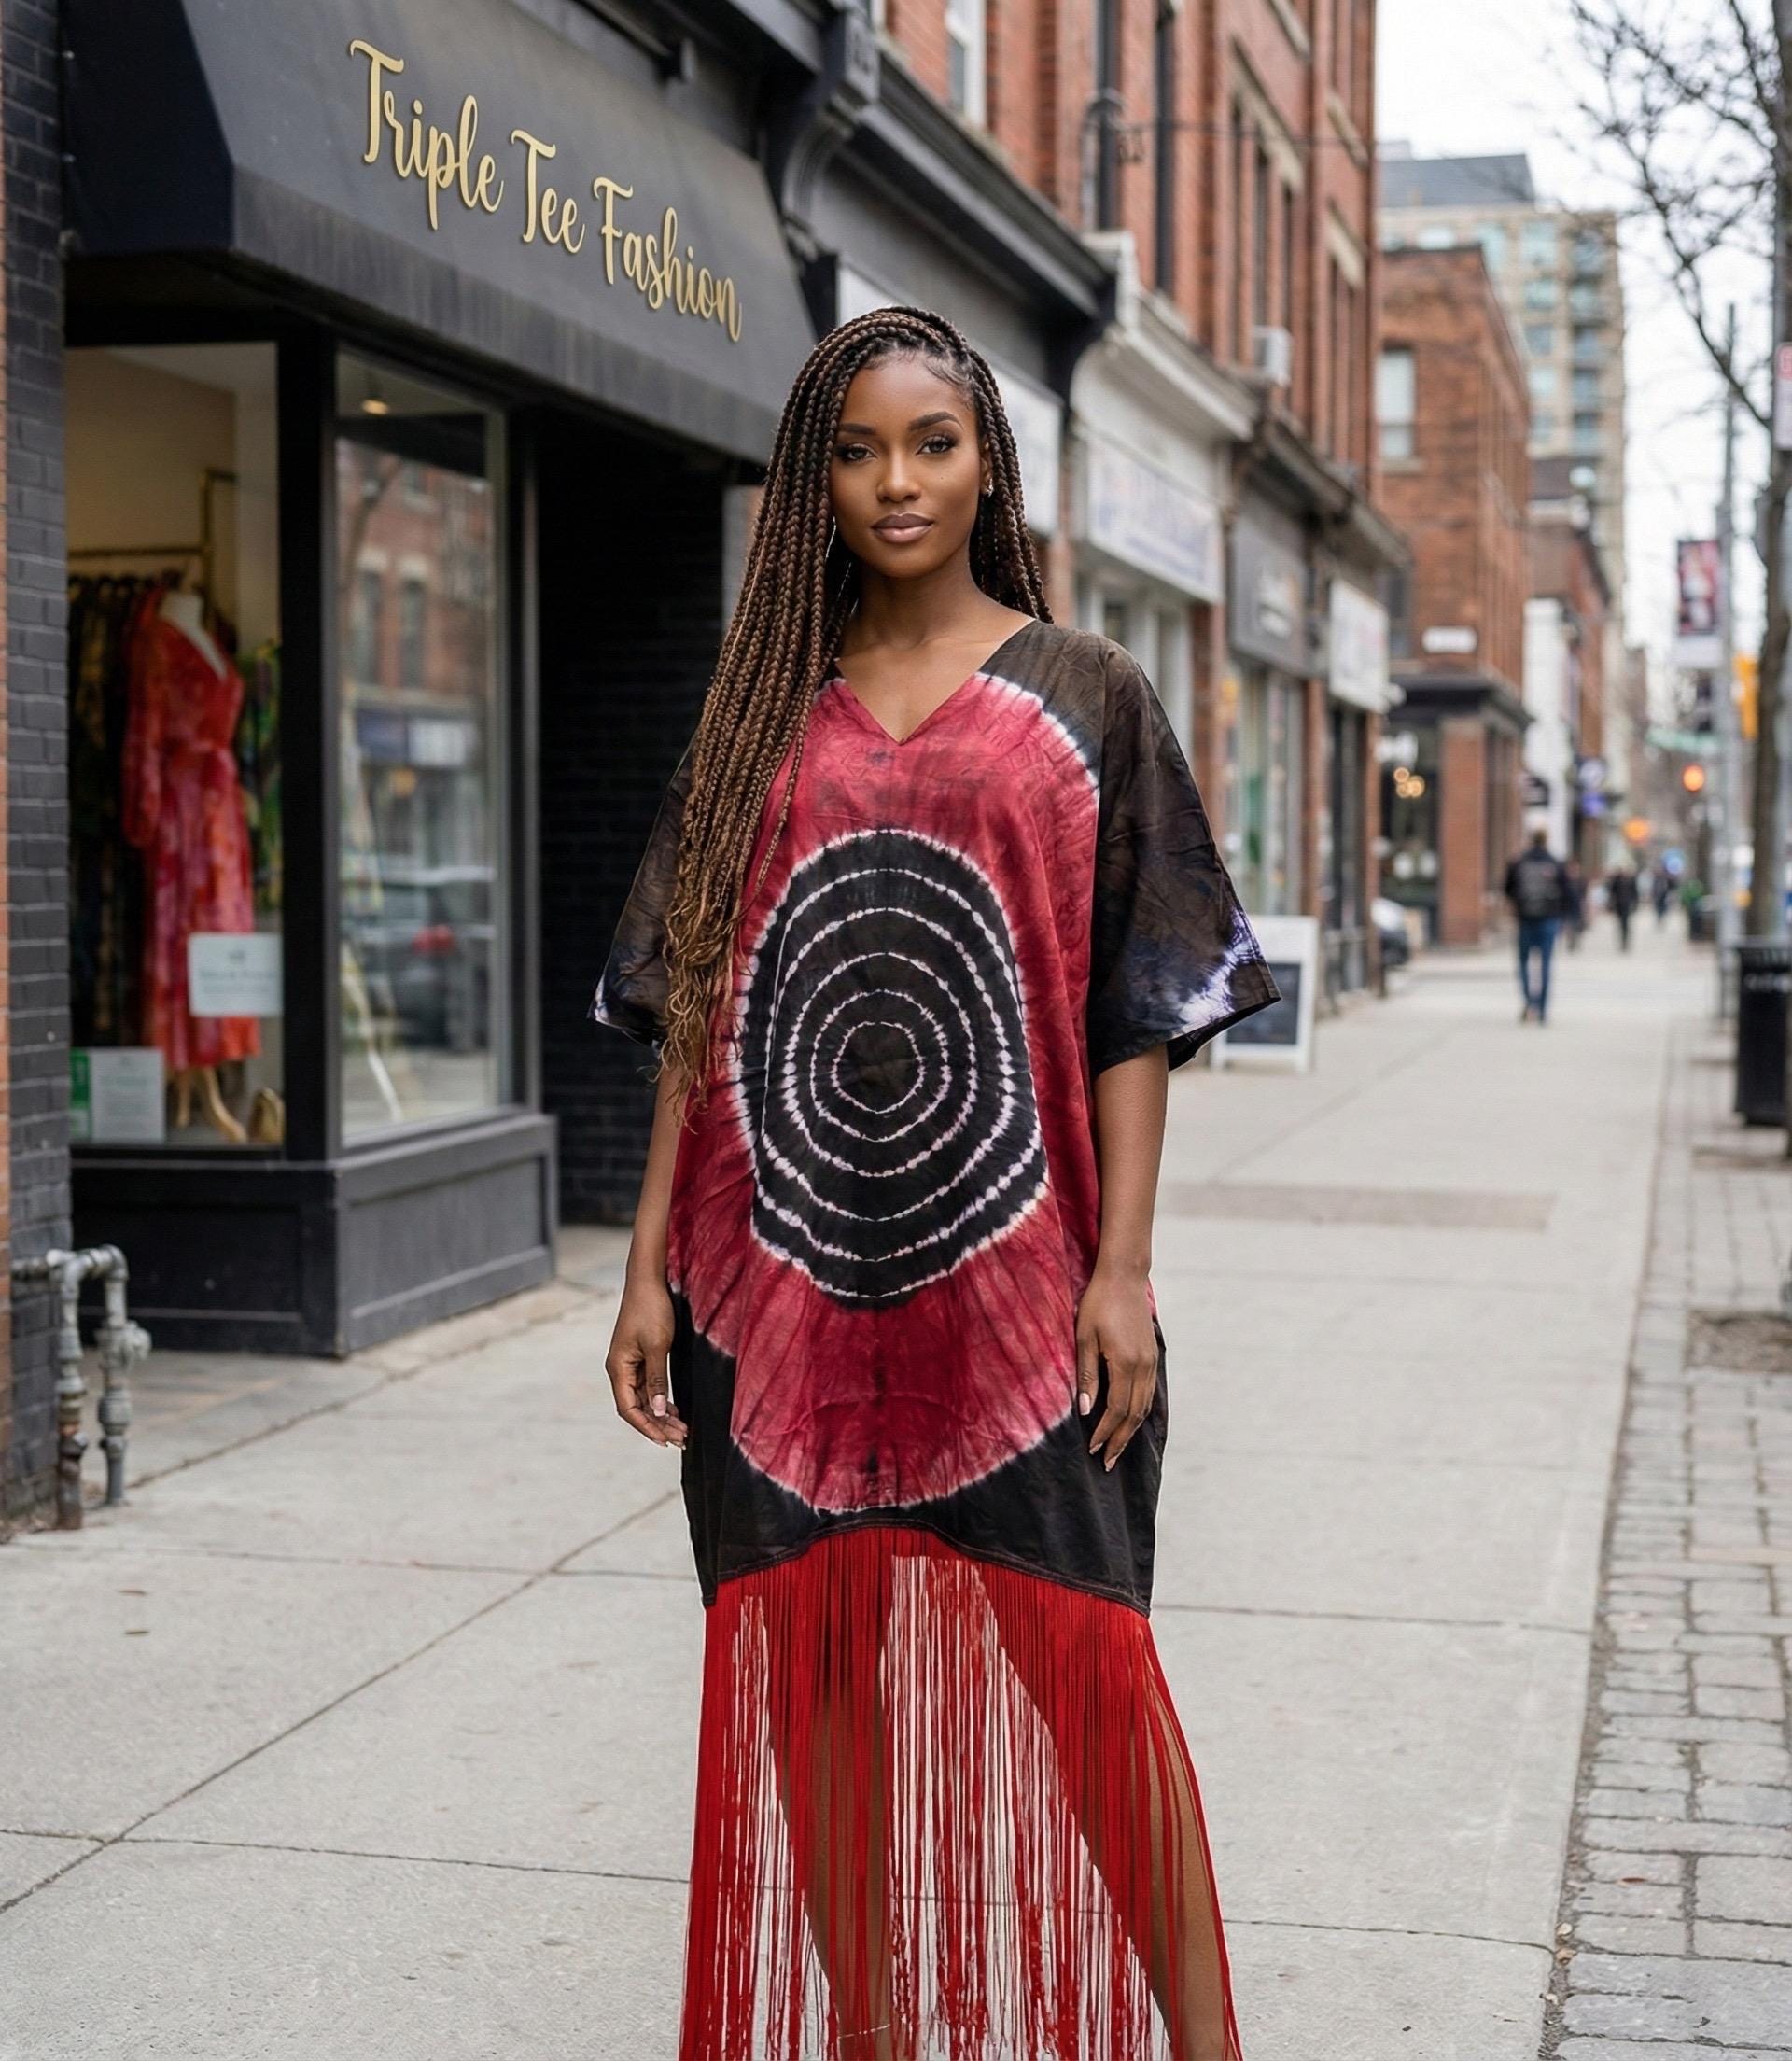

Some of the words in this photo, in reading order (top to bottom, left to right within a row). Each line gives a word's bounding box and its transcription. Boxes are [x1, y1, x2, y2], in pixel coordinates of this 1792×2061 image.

[349, 39, 504, 231] Triple
[511, 129, 586, 254] Tee
[593, 176, 743, 343] Fashion
